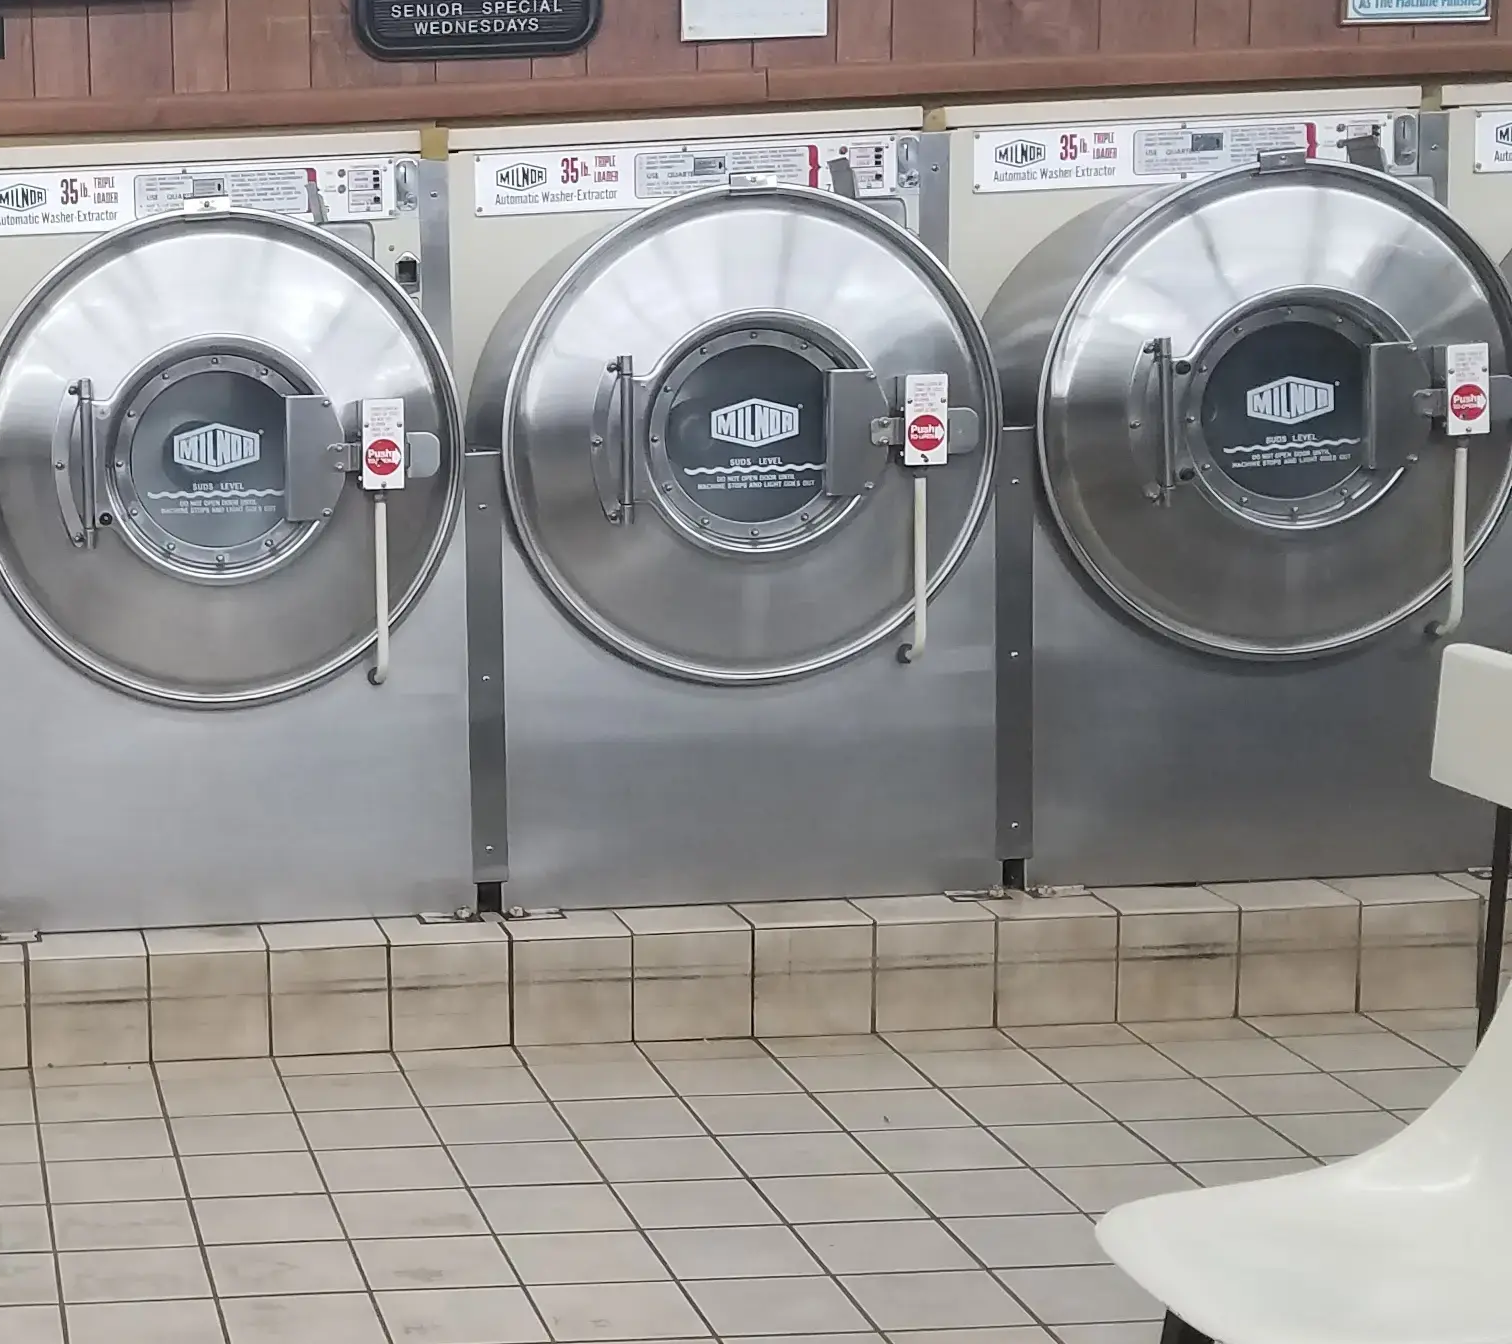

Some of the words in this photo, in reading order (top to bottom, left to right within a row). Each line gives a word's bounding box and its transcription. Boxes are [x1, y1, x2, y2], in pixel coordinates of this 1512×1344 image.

[391, 4, 463, 18] SENIOR
[482, 0, 563, 14] SPECIAL
[414, 19, 539, 35] WEDNESDAYS
[1094, 132, 1114, 144] TRIPLE
[1060, 134, 1077, 160] 35
[1080, 138, 1089, 153] lb.
[1093, 147, 1117, 159] LOADER
[998, 144, 1043, 164] MILNOR
[594, 155, 616, 167] TRIPLE
[561, 158, 578, 184] 35
[581, 162, 591, 176] lb.
[594, 171, 618, 182] LOADER
[994, 170, 1037, 182] Automatic
[94, 177, 114, 188] TRIPLE
[499, 168, 544, 188] MILNOR
[61, 179, 78, 205] 35
[80, 184, 90, 198] lb.
[94, 192, 118, 204] LOADER
[0, 189, 44, 208] MILNOR
[495, 193, 539, 205] Automatic
[1453, 394, 1476, 403] Push
[717, 405, 793, 441] MILNOR
[911, 424, 934, 433] Push
[180, 430, 253, 466] MILNOR
[368, 449, 391, 457] Push
[730, 458, 751, 466] SUDS
[759, 457, 782, 465] LEVEL
